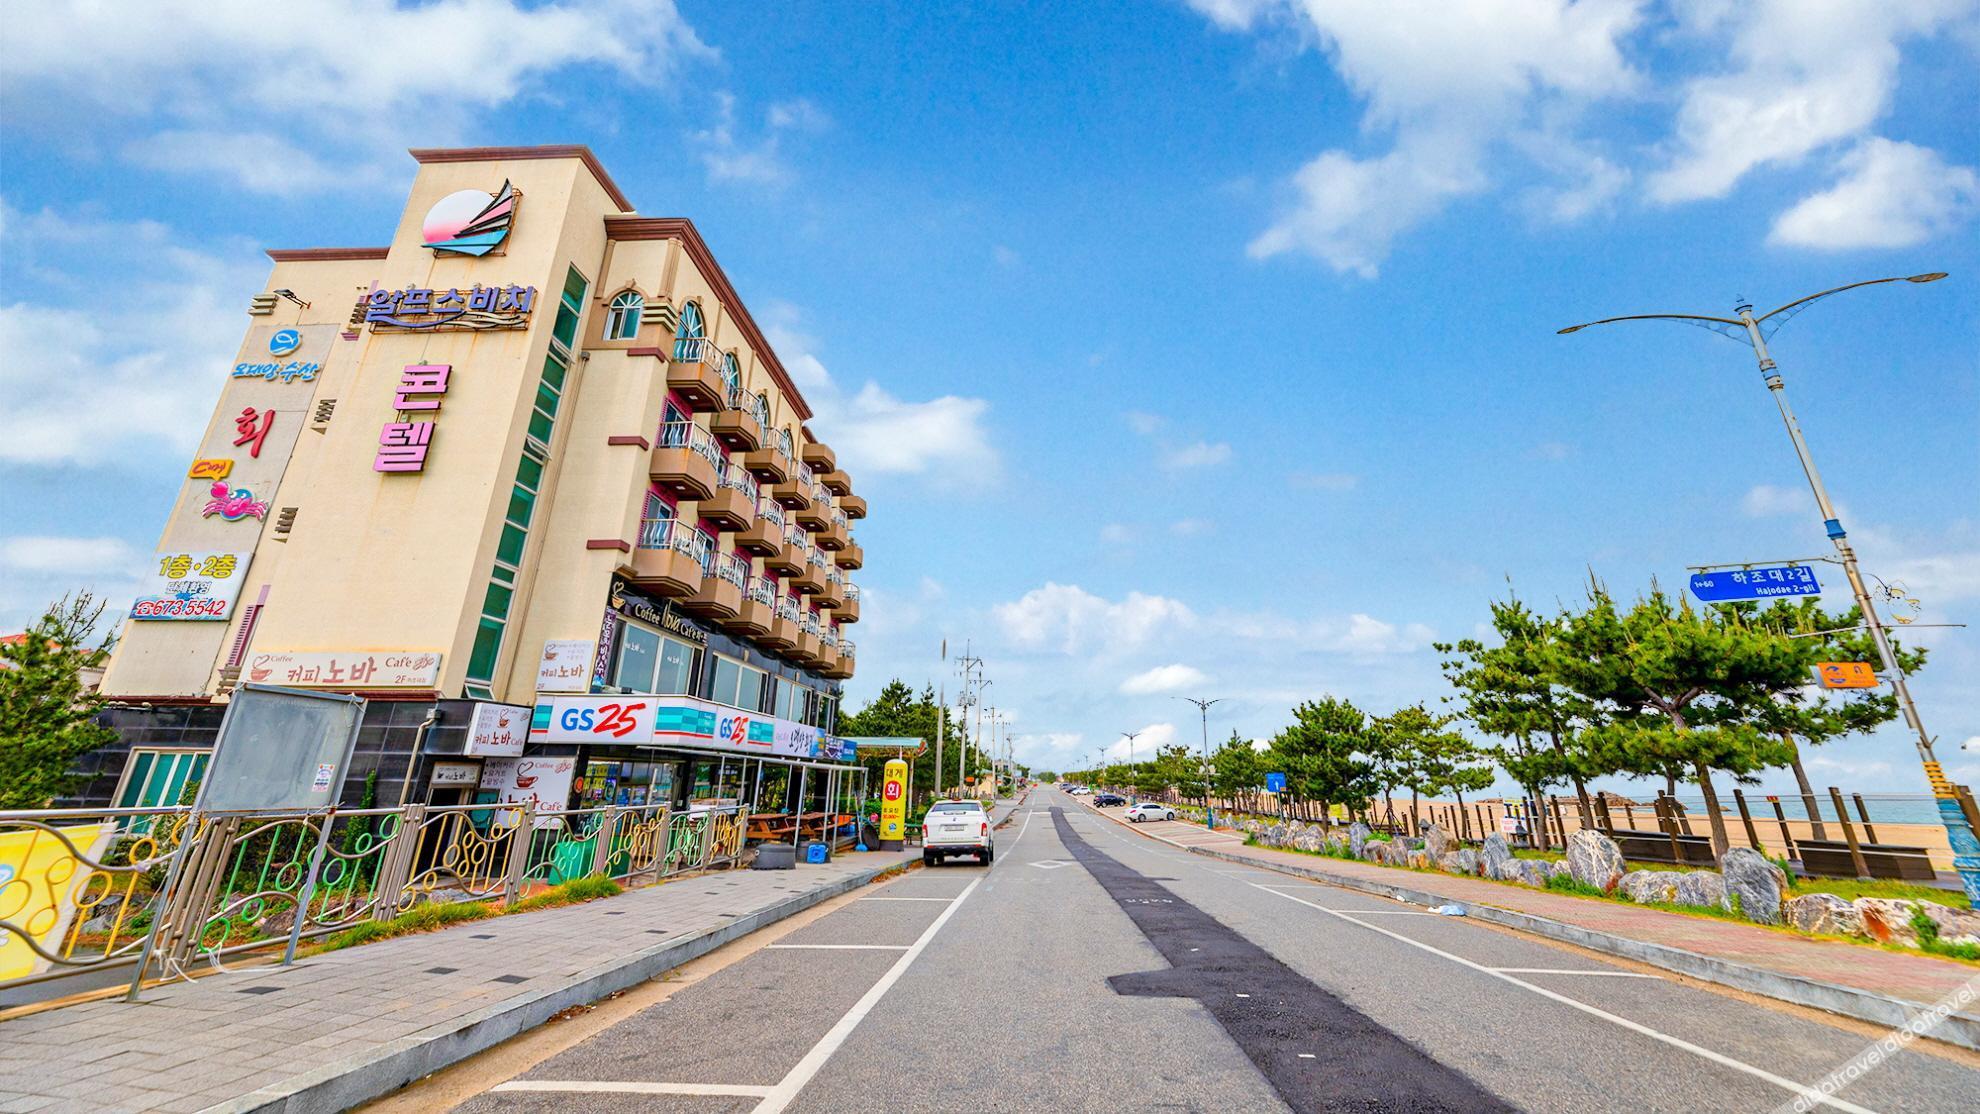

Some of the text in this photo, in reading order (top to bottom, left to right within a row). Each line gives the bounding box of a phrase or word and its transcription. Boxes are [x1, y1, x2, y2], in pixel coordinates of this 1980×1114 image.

[365, 285, 538, 323] 알프스비치
[233, 406, 276, 459] 회
[1756, 585, 1792, 596] Hajodae
[634, 603, 661, 625] Coffee
[270, 655, 293, 663] Coffee
[288, 656, 377, 684] 커피 노바
[395, 674, 407, 684] 2F
[541, 664, 584, 678] 커피 노바
[561, 702, 646, 738] GS25
[475, 734, 489, 745] 커피
[490, 731, 512, 745] 노바
[720, 716, 749, 745] GS25
[887, 783, 900, 798] 회
